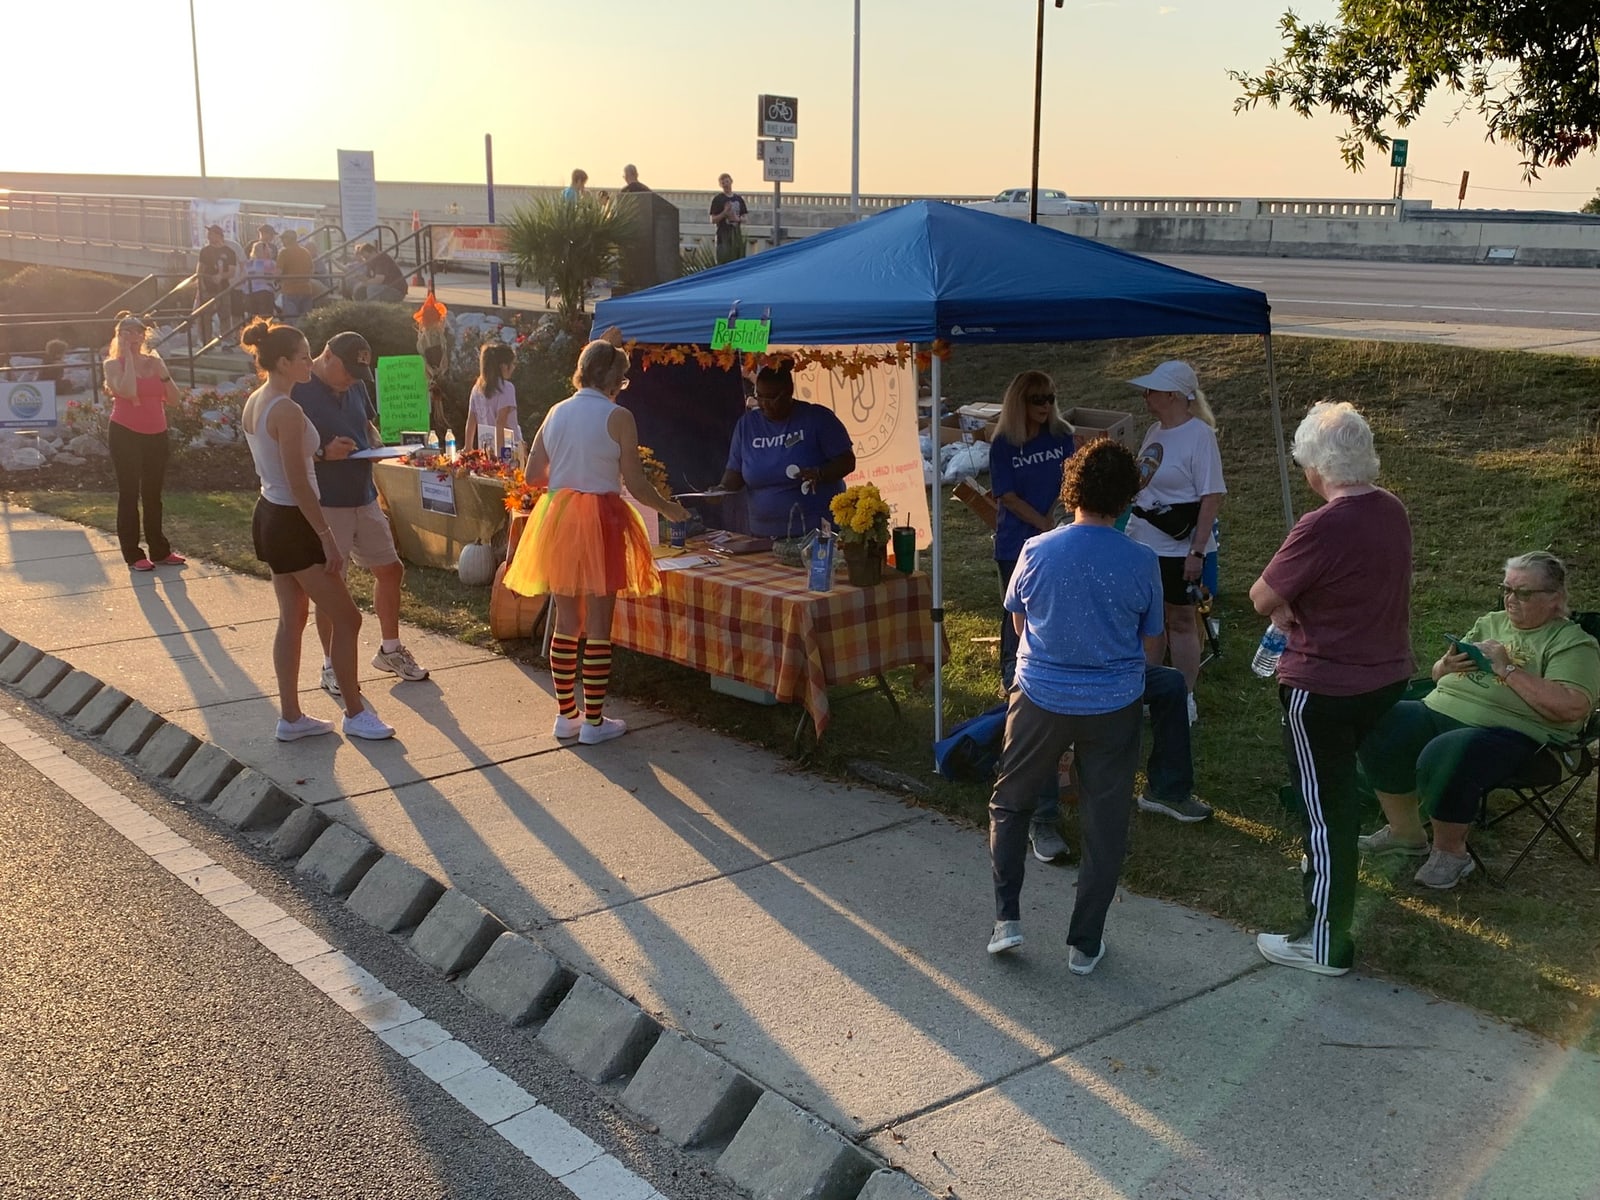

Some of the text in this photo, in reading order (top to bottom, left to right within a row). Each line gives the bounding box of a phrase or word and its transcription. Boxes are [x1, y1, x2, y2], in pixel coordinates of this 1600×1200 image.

[775, 145, 784, 154] NO
[769, 157, 789, 166] MOTOR
[1012, 446, 1064, 468] CIVITAN
